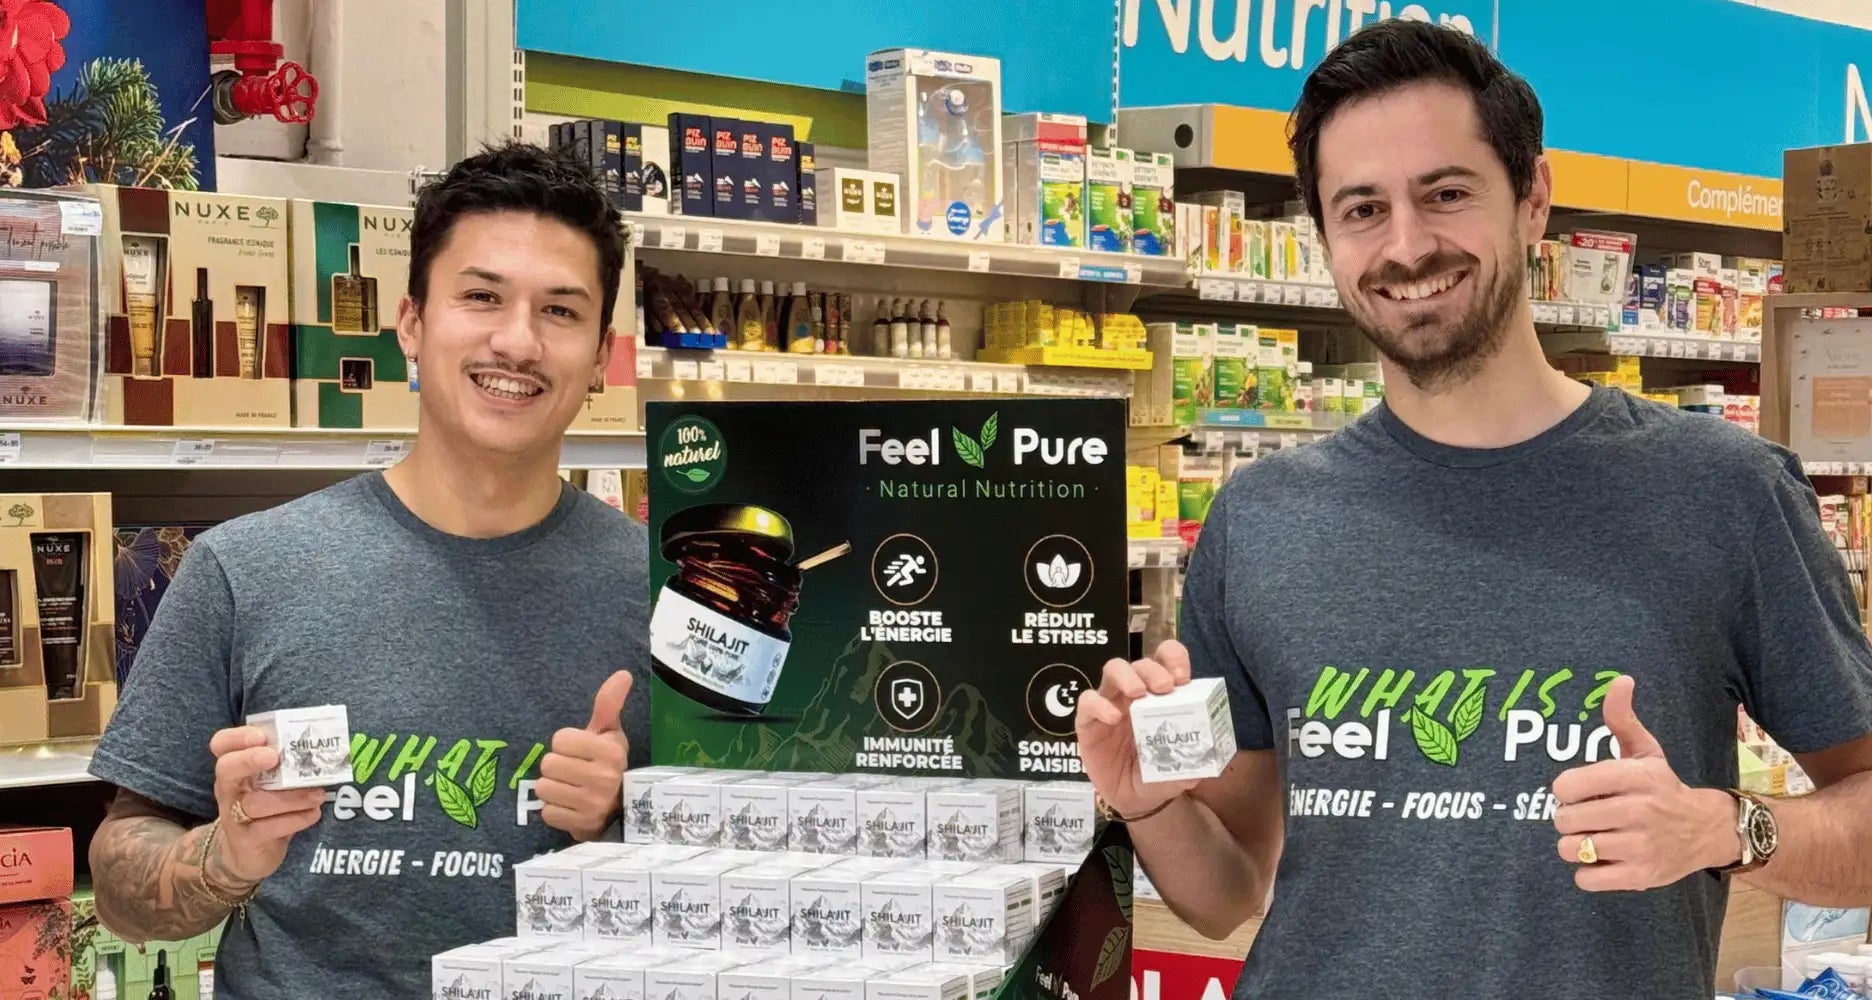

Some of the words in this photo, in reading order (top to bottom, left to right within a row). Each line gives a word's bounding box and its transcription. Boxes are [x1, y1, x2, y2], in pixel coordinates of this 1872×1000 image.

[1121, 0, 1474, 69] Nutrit
[175, 201, 250, 221] NUXE
[3, 395, 48, 406] NUXE
[677, 425, 707, 445] 100%
[663, 440, 721, 469] naturel
[858, 428, 941, 466] Feel
[1013, 428, 1108, 466] Pure
[879, 479, 967, 499] Natural
[976, 480, 1086, 499] Nutrition
[37, 545, 71, 553] NUXE
[868, 610, 944, 627] BOOSTE
[1024, 609, 1095, 629] RÉDUIT
[686, 617, 750, 656] SHILAJIT
[860, 625, 953, 643] L'ÉNERGIE
[1011, 628, 1034, 645] LE
[1038, 629, 1109, 646] STRESS
[1305, 665, 1496, 724] WHAT
[1498, 668, 1573, 722] IS
[1145, 730, 1201, 747] SHILAJIT
[1286, 706, 1390, 761] Feel
[290, 736, 341, 752] SHILAJIT
[863, 735, 955, 754] IMMUNITÉ
[351, 733, 507, 788] WHAT
[855, 749, 964, 771] RENFORCÉE
[325, 772, 416, 823] eel
[1289, 785, 1376, 818] ÉNERGIE
[1401, 791, 1484, 821] FOCUS
[662, 812, 711, 825] SHILAJIT
[729, 814, 779, 827] SHILAJIT
[797, 817, 848, 829] SHILAJIT
[865, 820, 915, 832] SHILAJIT
[1034, 815, 1085, 829] SHILAJIT
[937, 823, 988, 835] SHILAJIT
[309, 841, 405, 877] ÉNERGIE
[430, 851, 504, 878] FOCUS
[525, 894, 573, 907] SHILAJIT
[591, 898, 640, 911] SHILAJIT
[661, 901, 710, 914] SHILAJIT
[729, 905, 780, 919] SHILAJIT
[801, 907, 851, 921] SHILAJIT
[870, 911, 922, 925] SHILAJIT
[942, 915, 994, 929] SHILAJIT
[441, 986, 491, 1000] SHILAJIT
